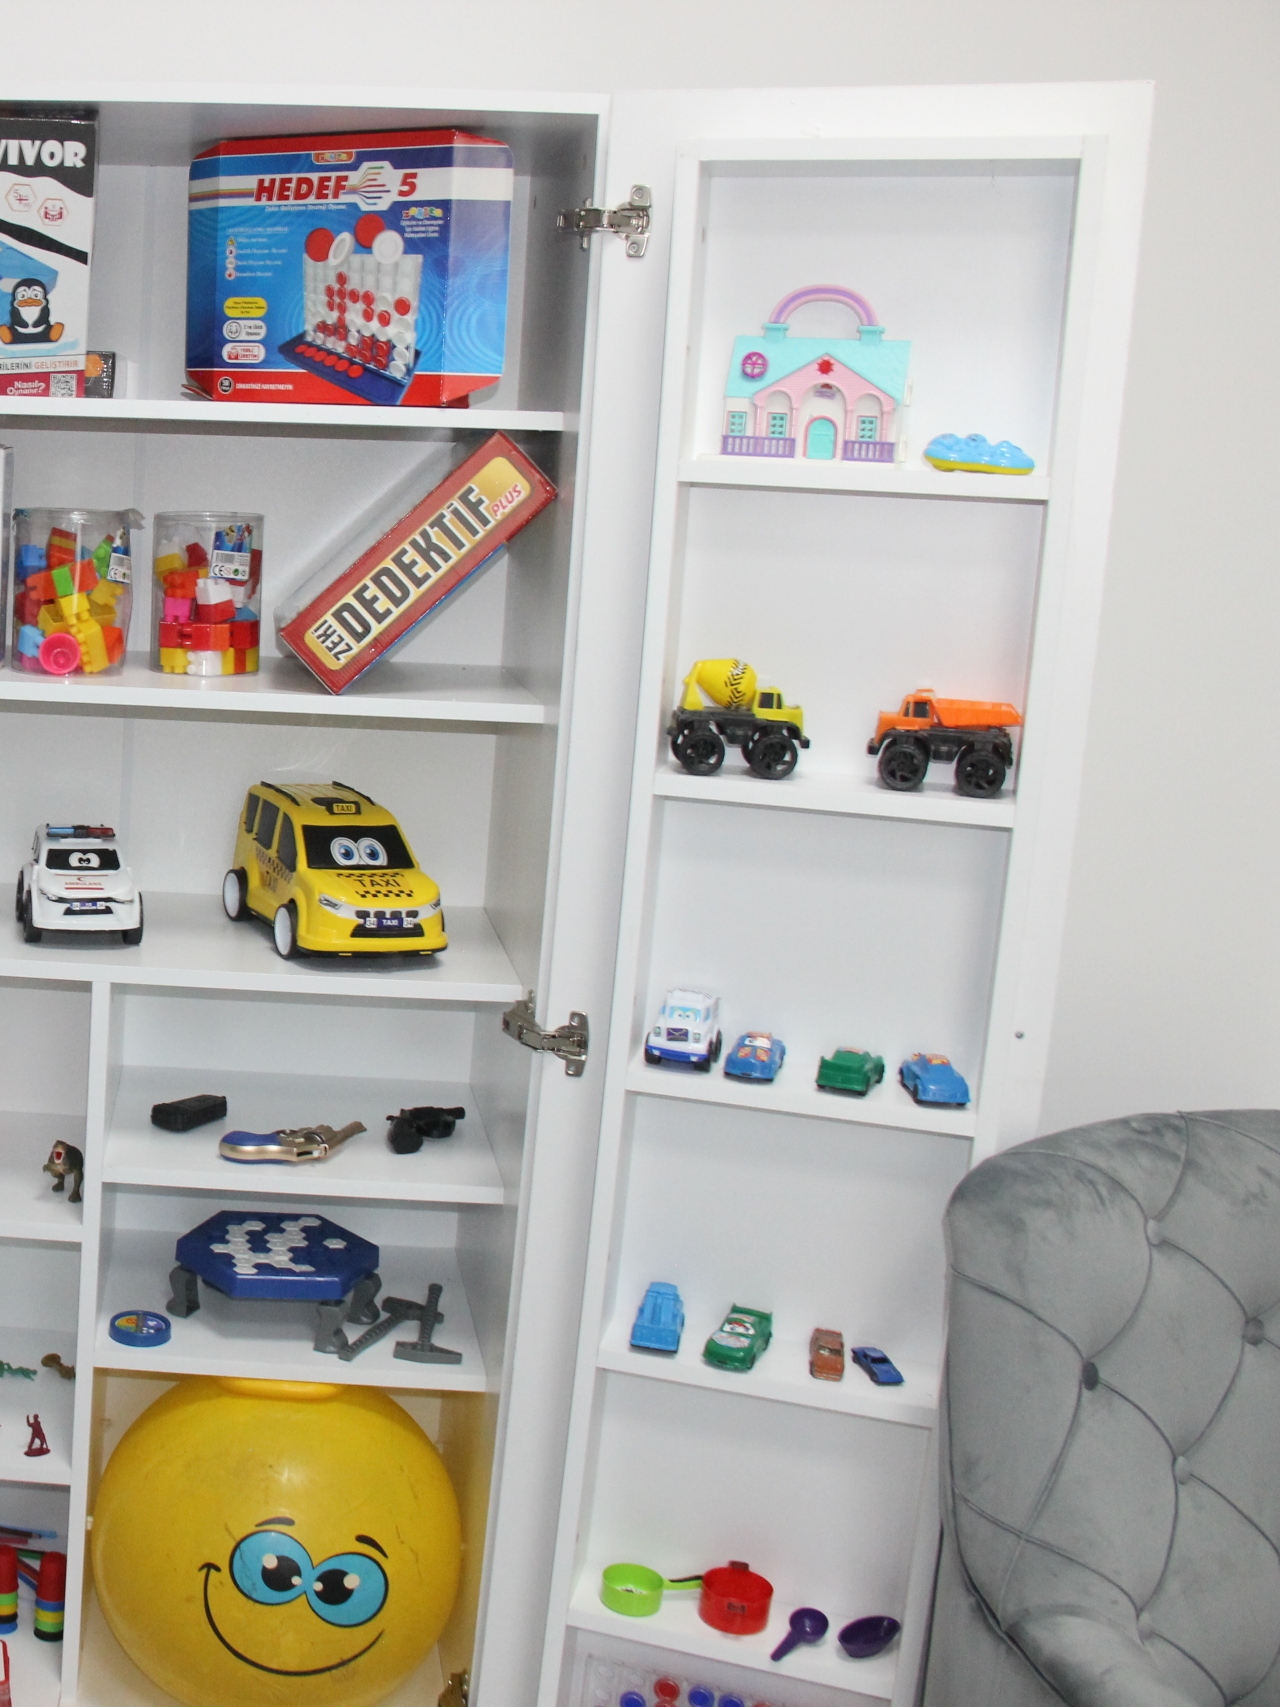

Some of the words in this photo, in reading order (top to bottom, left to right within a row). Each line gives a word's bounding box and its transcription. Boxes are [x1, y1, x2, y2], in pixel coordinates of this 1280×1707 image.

[254, 175, 349, 202] HEDEF
[397, 172, 418, 197] 5
[34, 360, 79, 370] GELİŞTİRİR
[14, 380, 40, 388] Nasıl
[490, 484, 523, 518] PLUS
[329, 484, 493, 645] DEDEKTİF
[311, 619, 354, 662] ZEKİ
[335, 804, 353, 812] TAXI
[354, 878, 401, 887] TAXI
